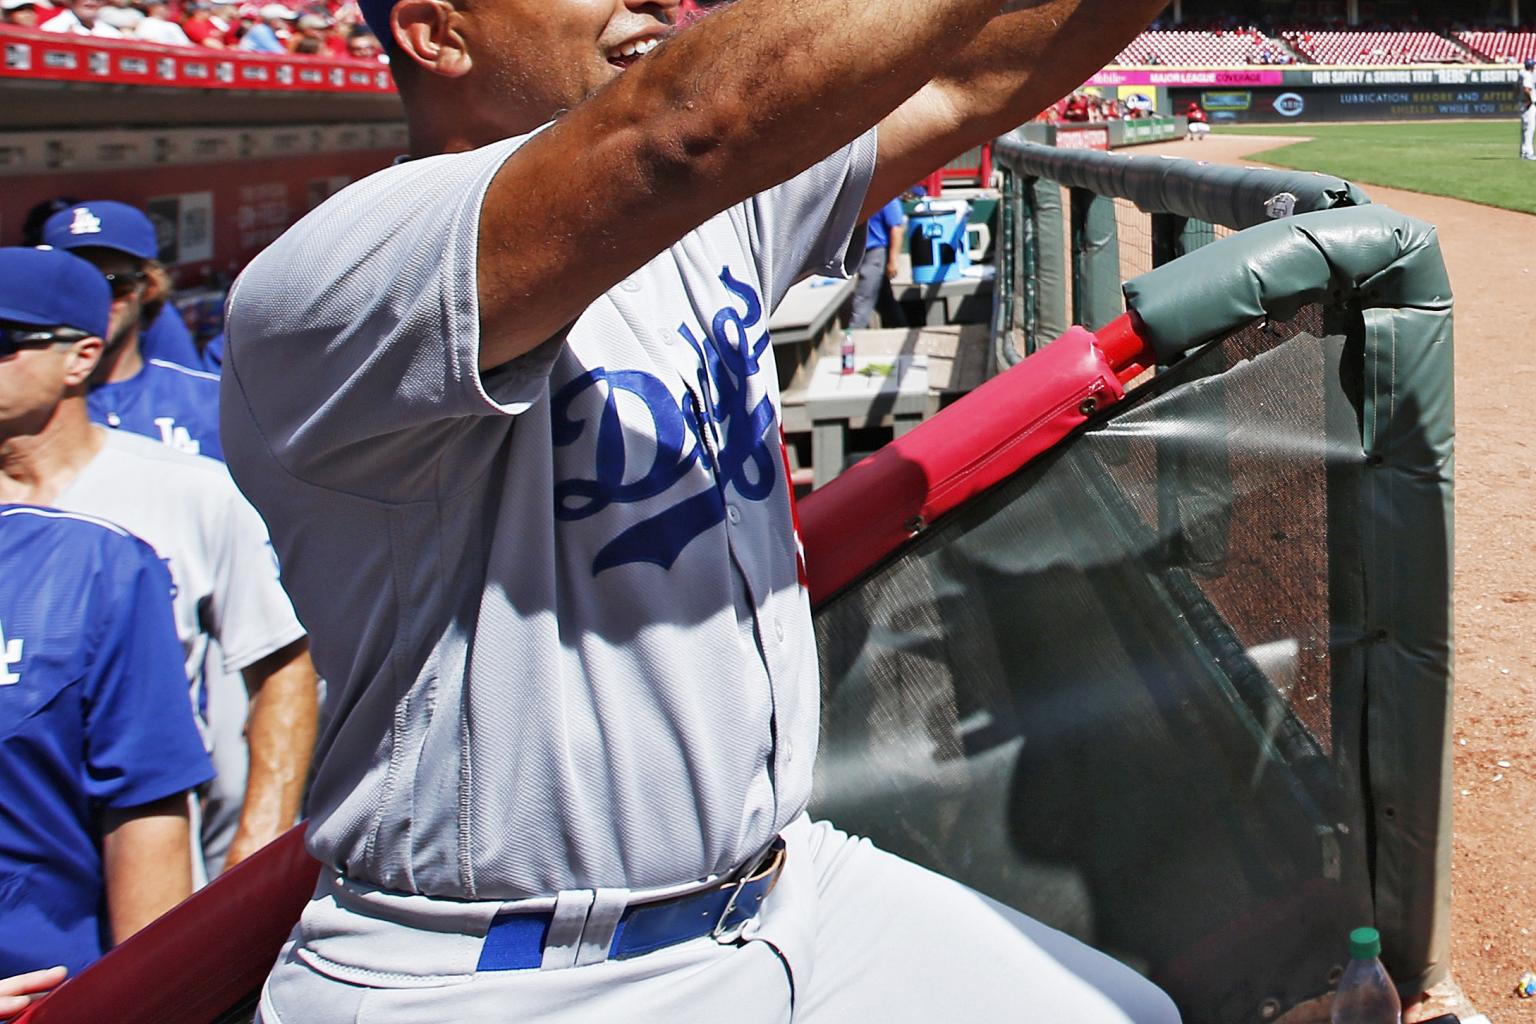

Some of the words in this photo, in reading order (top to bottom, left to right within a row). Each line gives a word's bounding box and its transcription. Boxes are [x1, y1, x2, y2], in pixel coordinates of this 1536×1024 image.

[1150, 72, 1179, 83] MAJOR
[1180, 72, 1216, 83] LEAGUE
[1216, 73, 1261, 83] COVERAGE
[1340, 93, 1408, 103] LUBRICATION
[1413, 92, 1452, 102] BEFORE
[1456, 92, 1479, 102] AND
[1483, 92, 1513, 101] AFTER
[1439, 104, 1470, 113] WHILE
[1473, 104, 1495, 113] YOU
